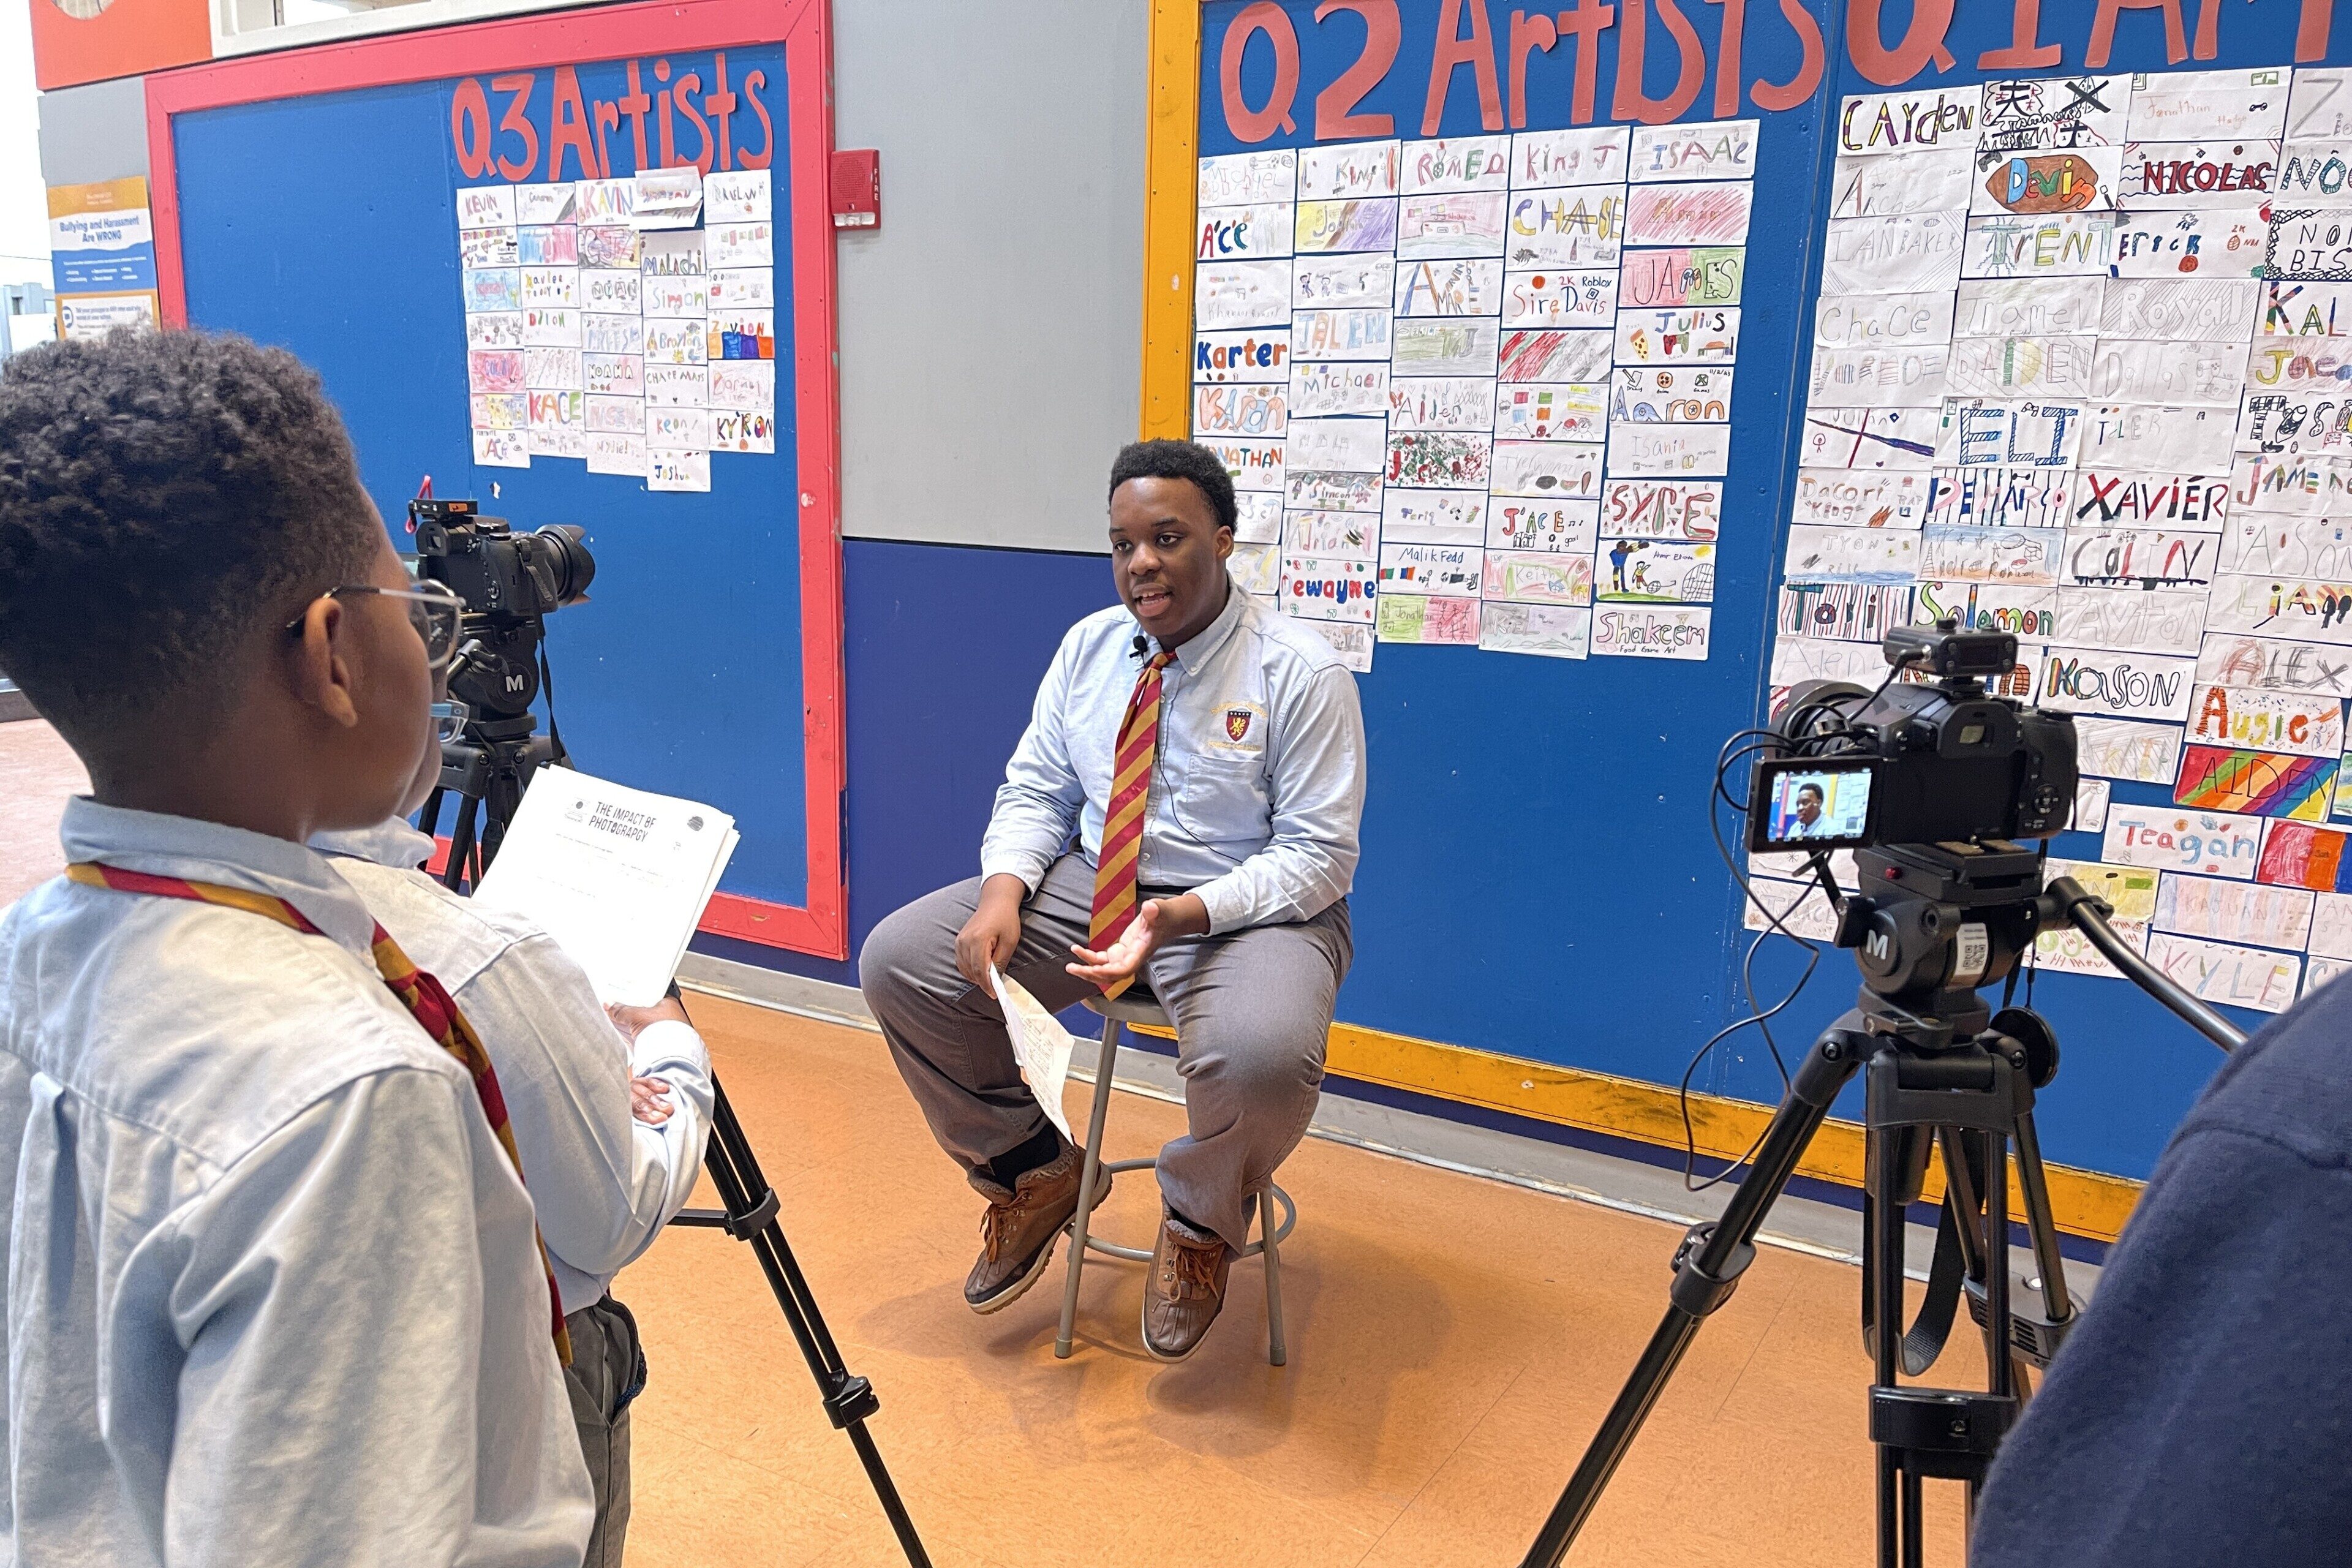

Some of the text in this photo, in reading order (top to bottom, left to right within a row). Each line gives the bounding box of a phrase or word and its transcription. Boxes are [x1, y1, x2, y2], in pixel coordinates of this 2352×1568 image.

[1220, 0, 1403, 143] Q2
[452, 53, 774, 182] Q3 Artists
[2144, 160, 2272, 194] NICOLAS
[59, 216, 140, 234] Bullying and Harassment
[82, 229, 121, 243] Are WRONG
[1582, 276, 1613, 287] Roblox
[1197, 338, 1287, 370] Karter
[1610, 385, 1725, 422] Aaron
[1959, 407, 2079, 467] ELI
[505, 674, 524, 693] M
[594, 800, 613, 817] THE
[612, 807, 645, 826] IMPACT
[2119, 819, 2256, 865] Teagan
[1865, 929, 1889, 960] M
